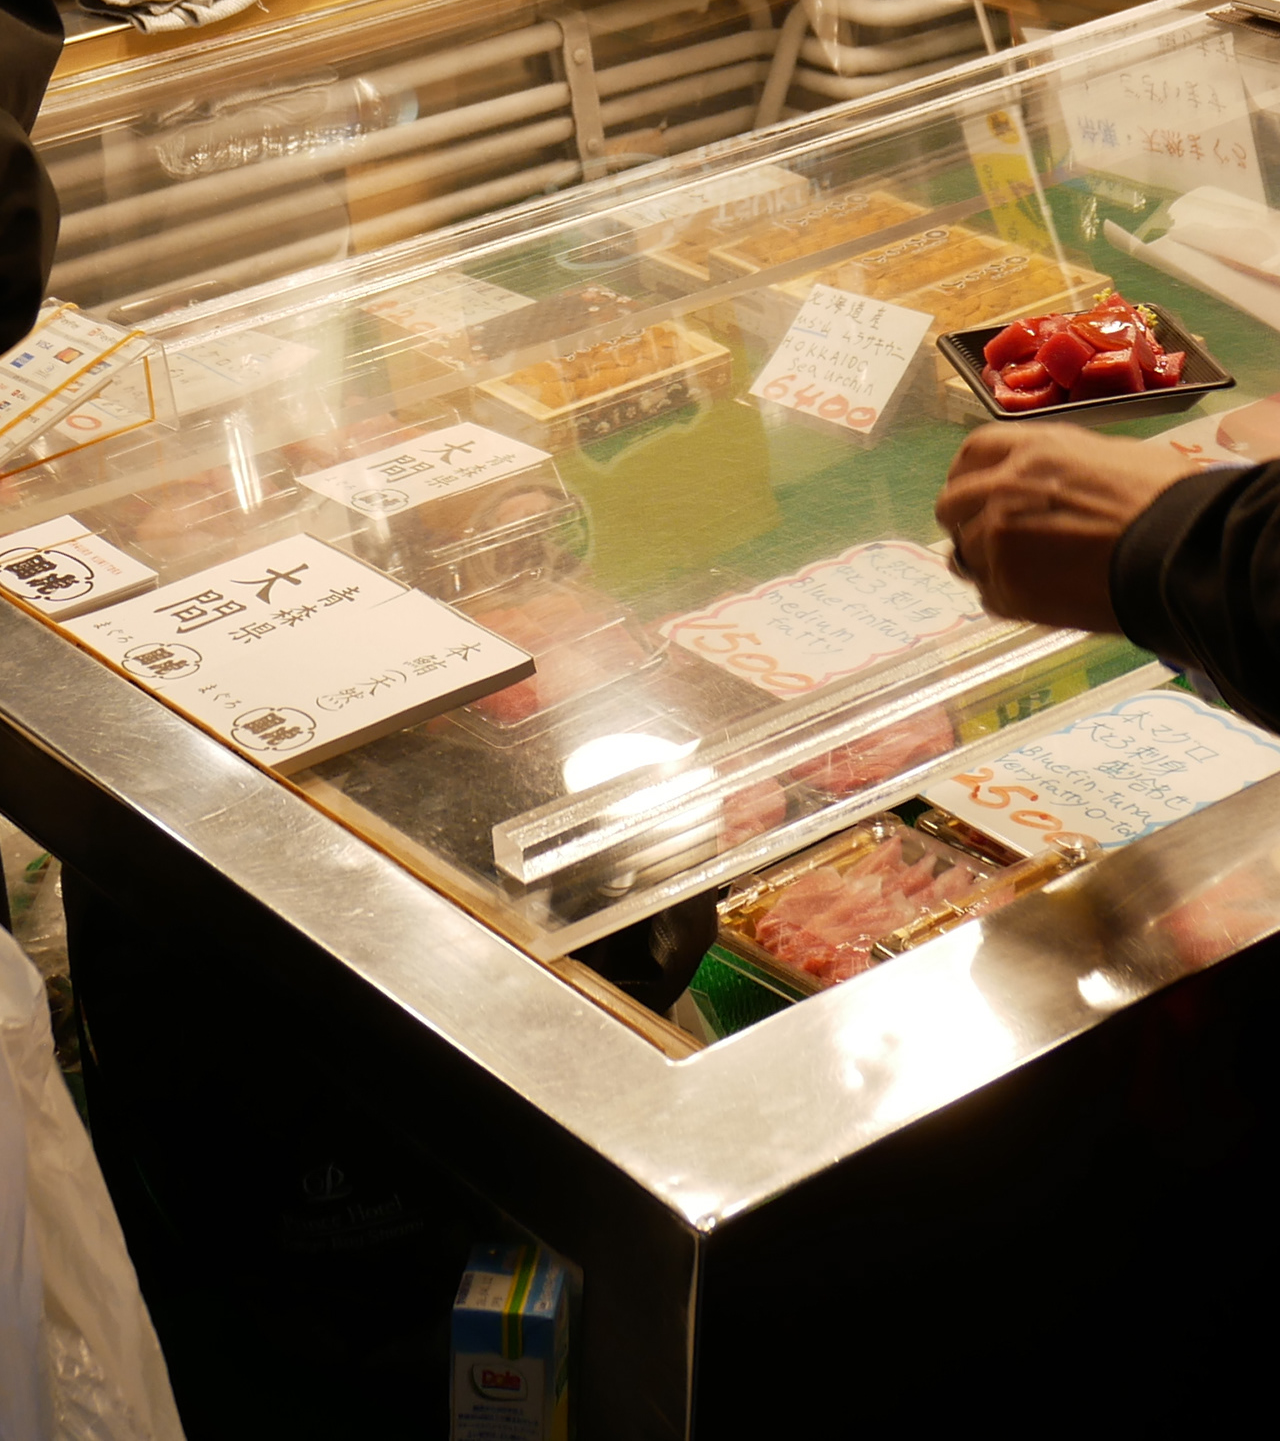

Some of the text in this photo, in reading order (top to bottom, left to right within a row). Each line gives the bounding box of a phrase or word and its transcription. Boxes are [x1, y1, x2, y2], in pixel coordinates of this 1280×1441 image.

[761, 372, 878, 429] 6400
[153, 562, 310, 635] 大間
[227, 585, 361, 645] 青森県
